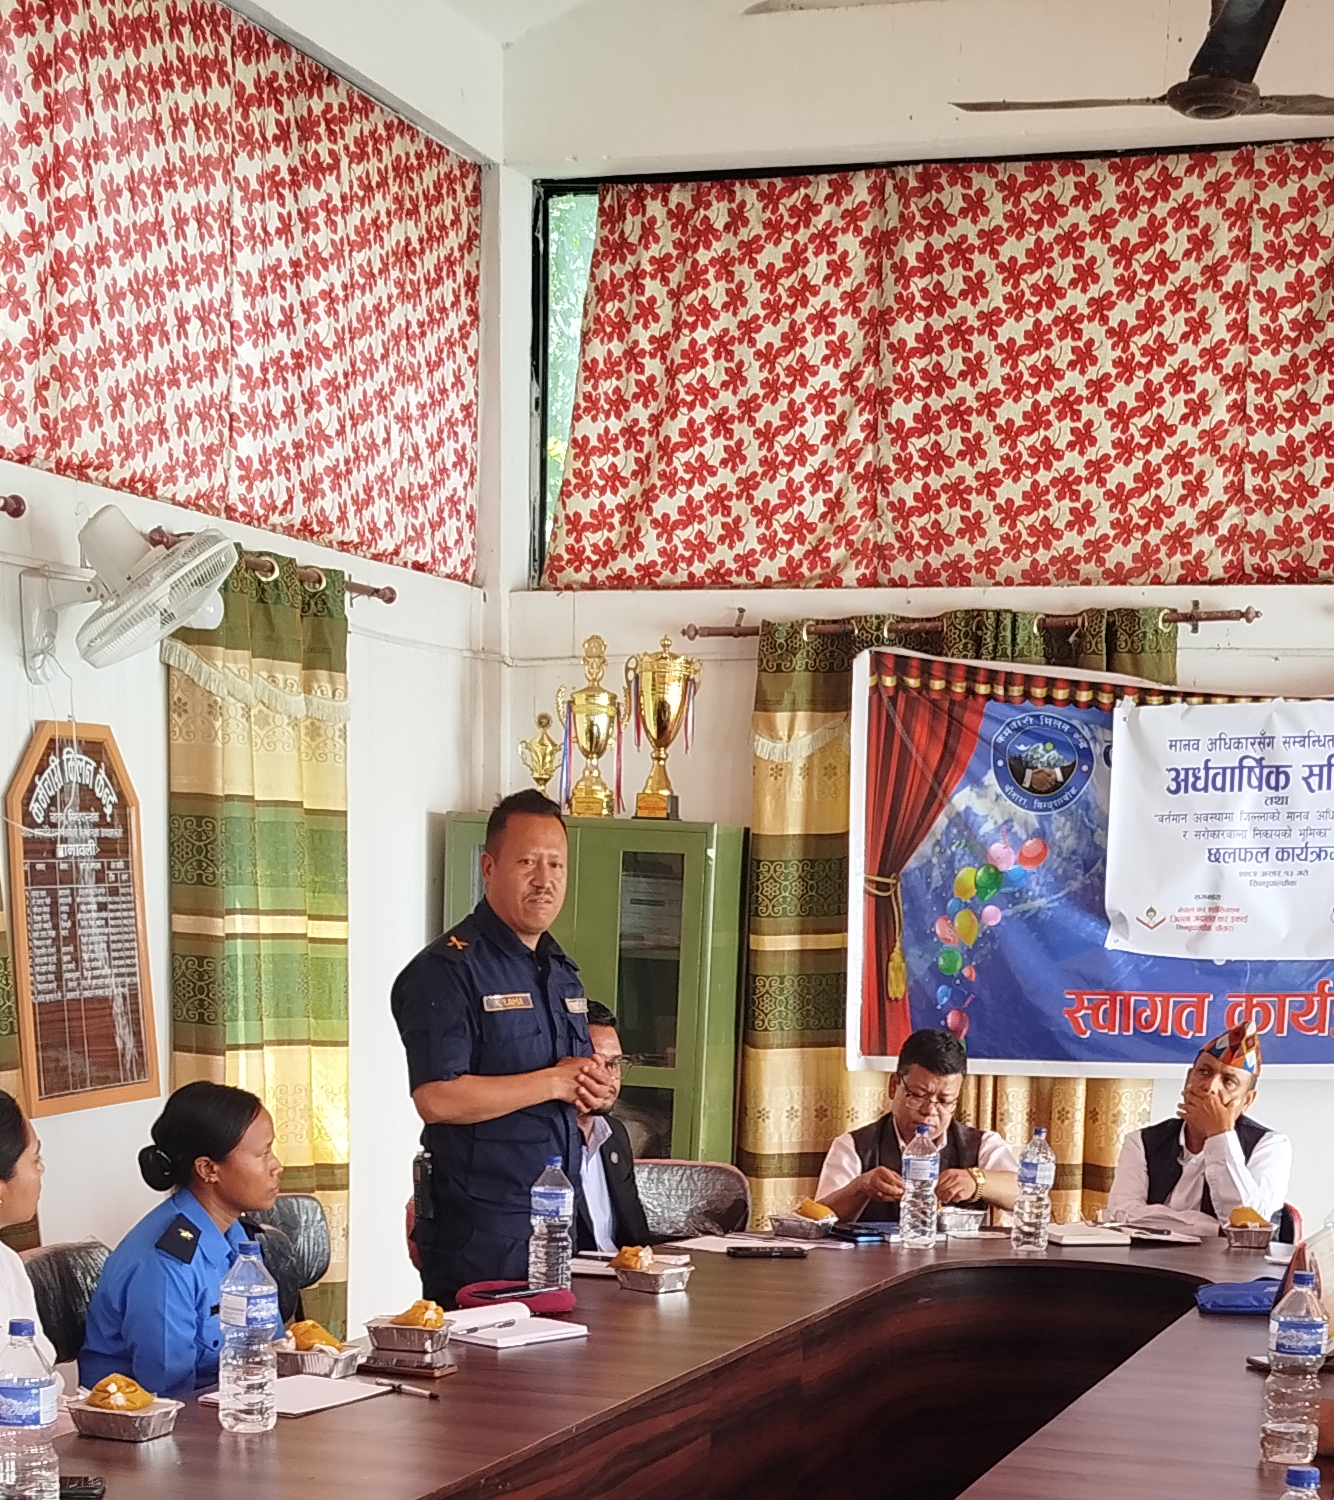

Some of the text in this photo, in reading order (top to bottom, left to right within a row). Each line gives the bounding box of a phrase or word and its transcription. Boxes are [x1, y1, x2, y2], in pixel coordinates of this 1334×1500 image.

[1168, 738, 1201, 752] मानव
[1207, 729, 1276, 753] अधिकारसँग
[1166, 755, 1293, 795] अर्धवार्षिक
[29, 756, 64, 824] कर्मचारी
[1264, 795, 1289, 806] तथा
[1194, 812, 1234, 823] अवस्थामा
[1286, 811, 1310, 821] मानव
[1207, 846, 1270, 864] छलफल
[1063, 989, 1213, 1039] स्वागत
